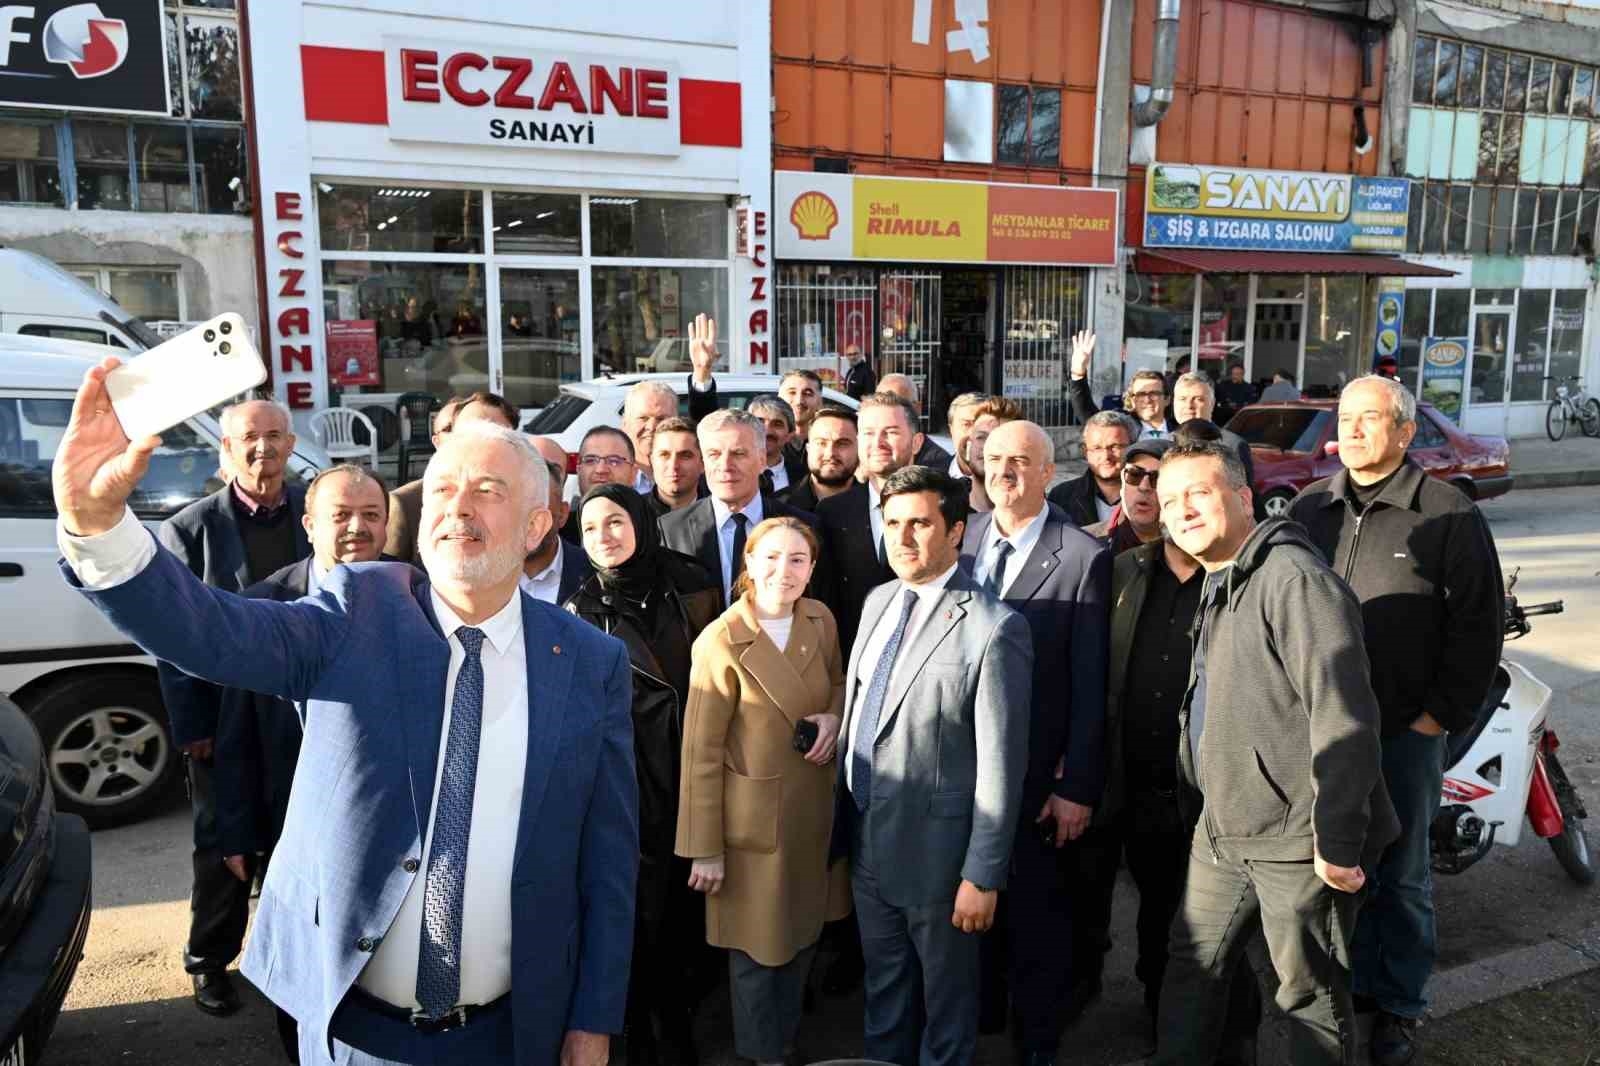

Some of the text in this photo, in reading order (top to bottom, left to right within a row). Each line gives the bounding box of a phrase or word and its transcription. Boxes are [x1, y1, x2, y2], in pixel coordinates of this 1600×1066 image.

[400, 48, 668, 119] ECZANE
[490, 119, 595, 144] SANAYİ
[1376, 186, 1404, 198] PAKET
[869, 202, 899, 216] Shell
[866, 218, 961, 237] RIMULA
[992, 213, 1110, 231] MEYDANLAR TİCARET
[1167, 215, 1193, 242] ŞİŞ
[1199, 222, 1209, 238] &
[1214, 221, 1271, 240] IZGARA
[1275, 224, 1335, 243] SALONU
[275, 192, 315, 410] ECZANE
[749, 212, 769, 376] ECZAN
